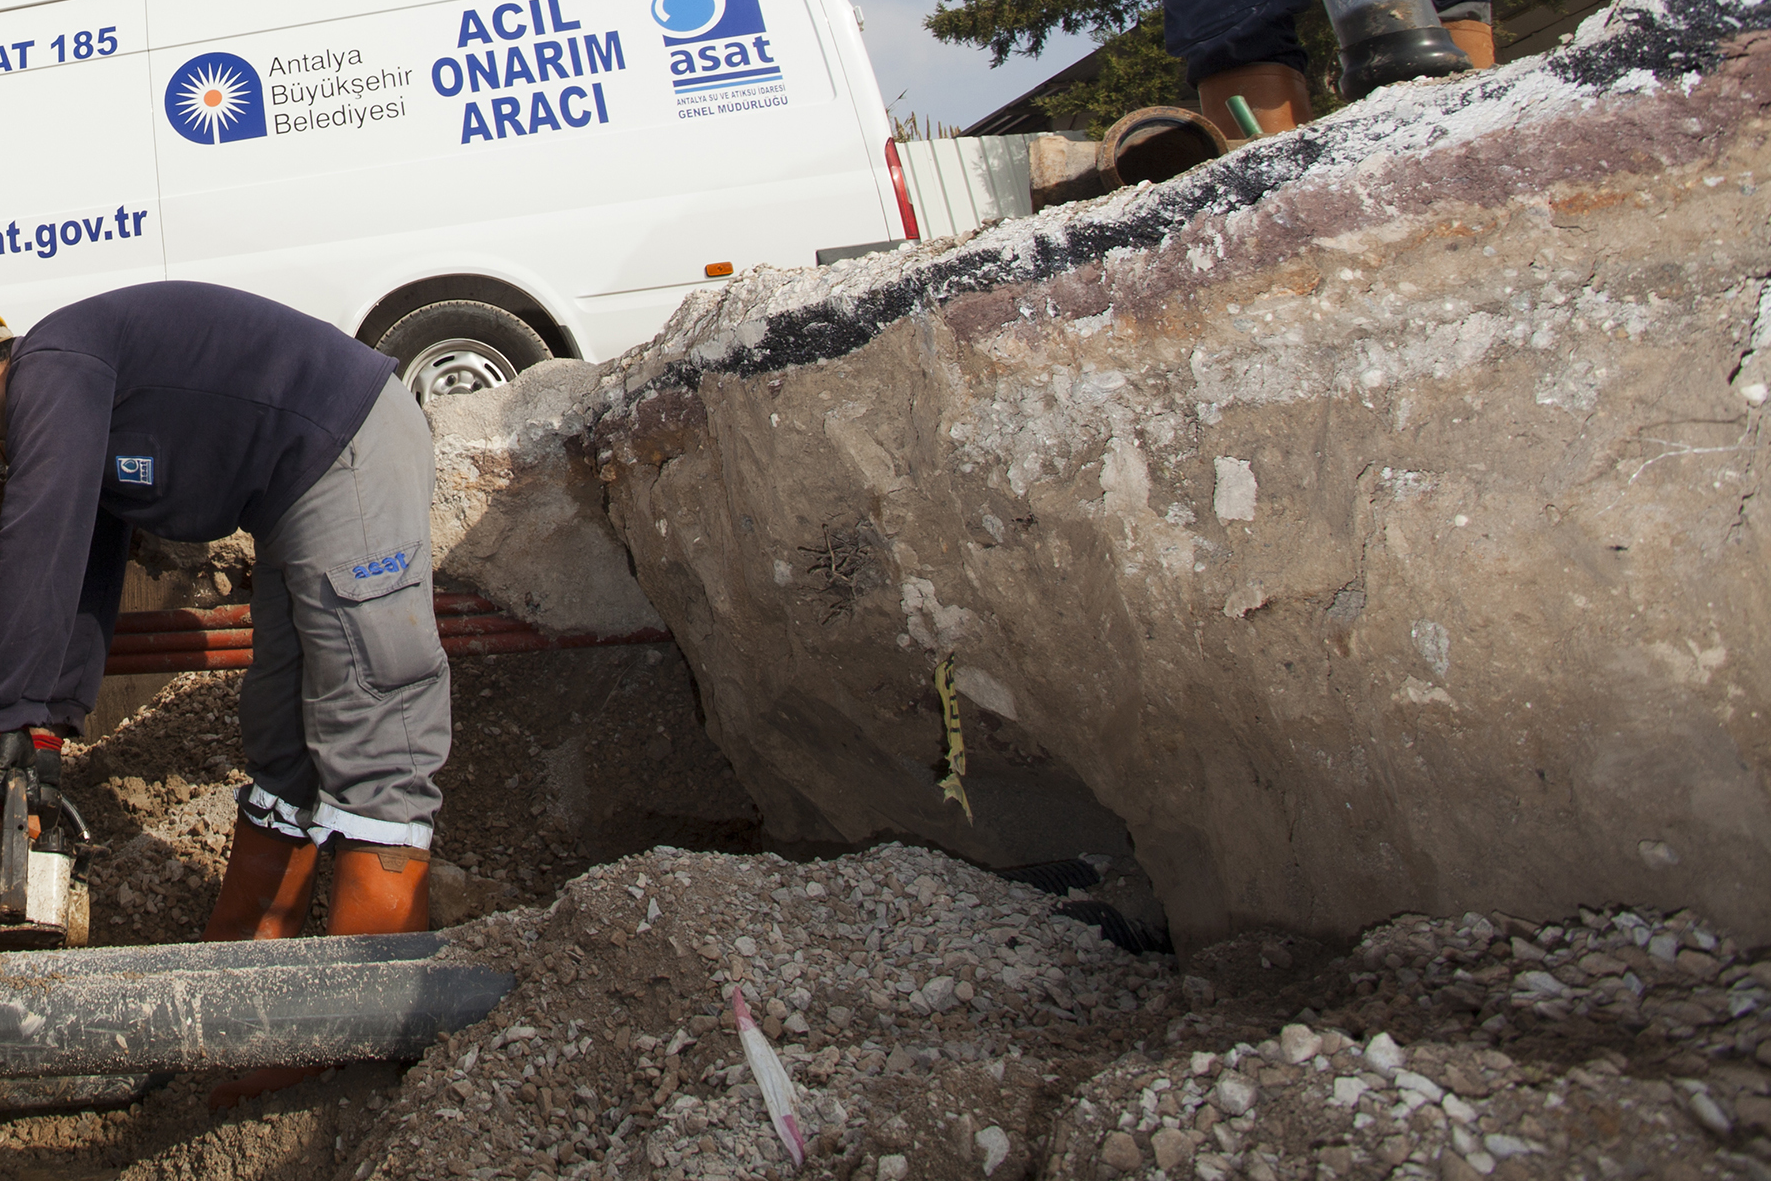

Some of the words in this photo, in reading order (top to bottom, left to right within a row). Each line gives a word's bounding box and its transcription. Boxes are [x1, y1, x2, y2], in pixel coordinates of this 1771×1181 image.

[50, 25, 118, 63] 185
[269, 48, 363, 78] Antalya
[670, 35, 775, 76] asat
[431, 30, 626, 98] ONARIM
[271, 66, 413, 107] Büyükşehir
[676, 95, 707, 106] ANTALYA
[709, 93, 718, 101] SU
[719, 91, 730, 100] VE
[731, 89, 757, 98] ATIKSU
[274, 95, 406, 135] Belediyesi
[460, 82, 610, 145] ARACI
[678, 106, 715, 119] GENEL
[717, 94, 789, 114] MÜDÜRLÜĞÜ
[352, 551, 409, 579] asat
